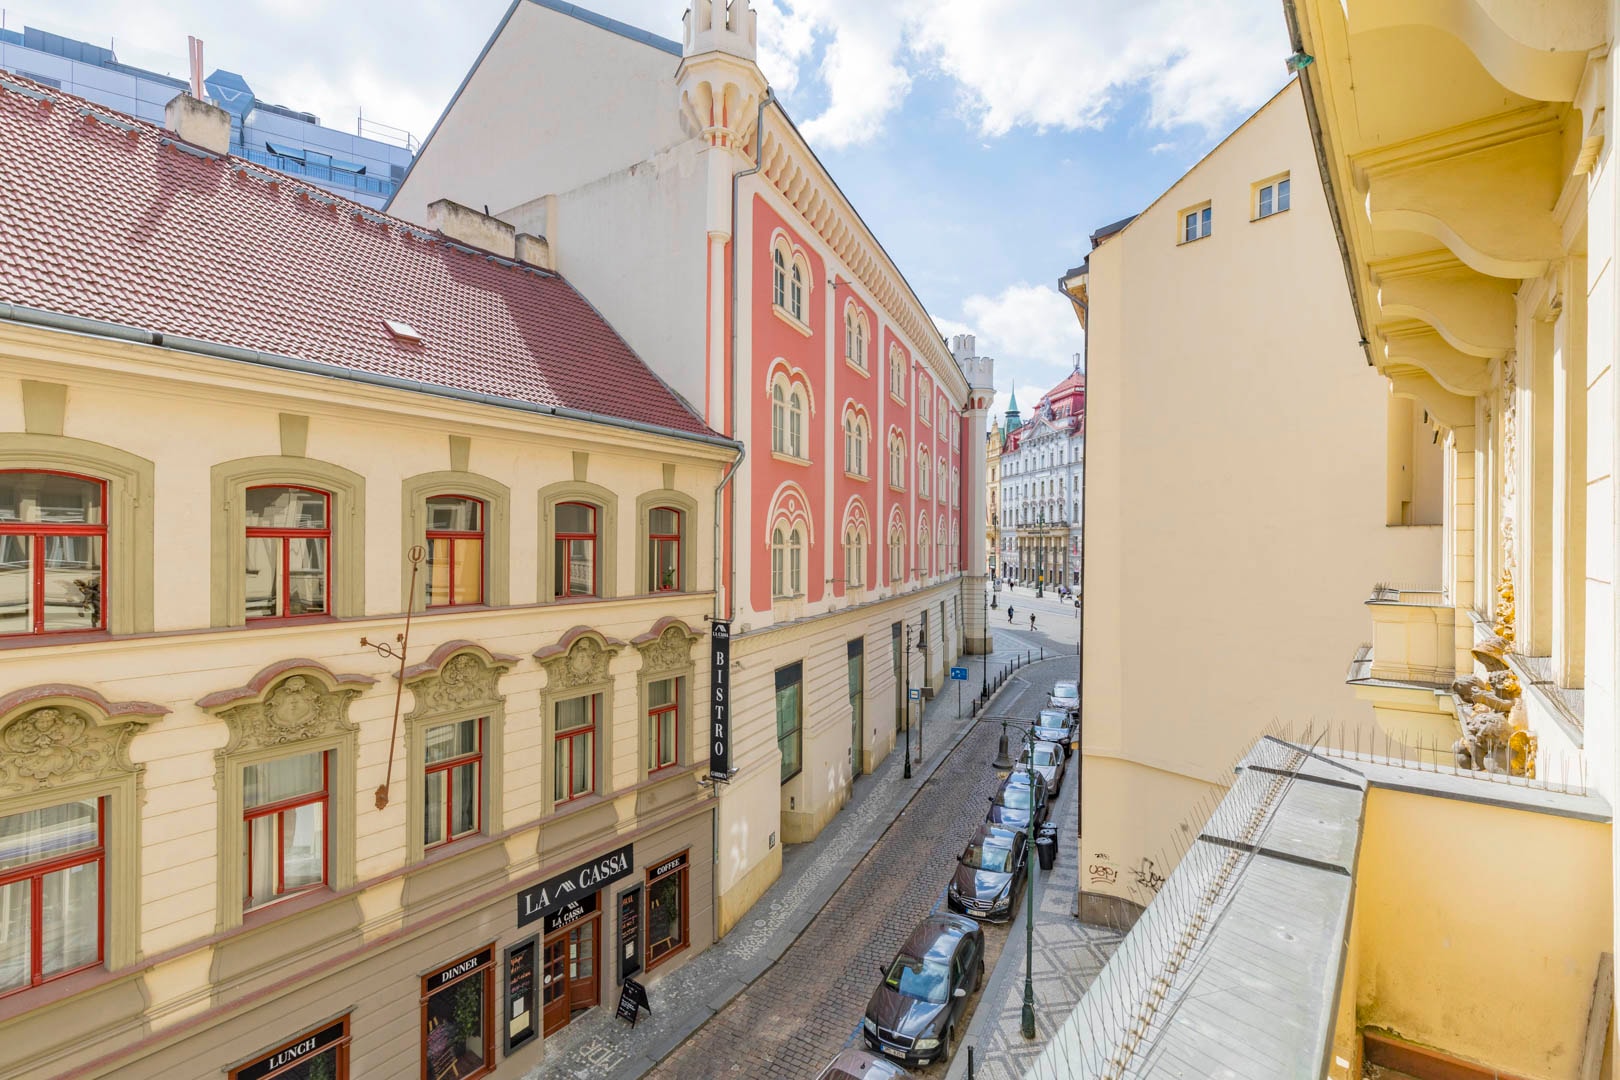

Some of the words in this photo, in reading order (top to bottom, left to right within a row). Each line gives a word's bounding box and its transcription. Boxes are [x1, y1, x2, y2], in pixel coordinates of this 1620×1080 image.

[715, 651, 724, 756] BISTRO
[656, 858, 680, 875] COFFEE
[525, 888, 550, 915] LA
[579, 853, 628, 888] CASSA
[551, 916, 562, 928] LA
[564, 906, 584, 921] CASSA
[441, 957, 478, 983] DINNER
[269, 1037, 316, 1069] LUNCH
